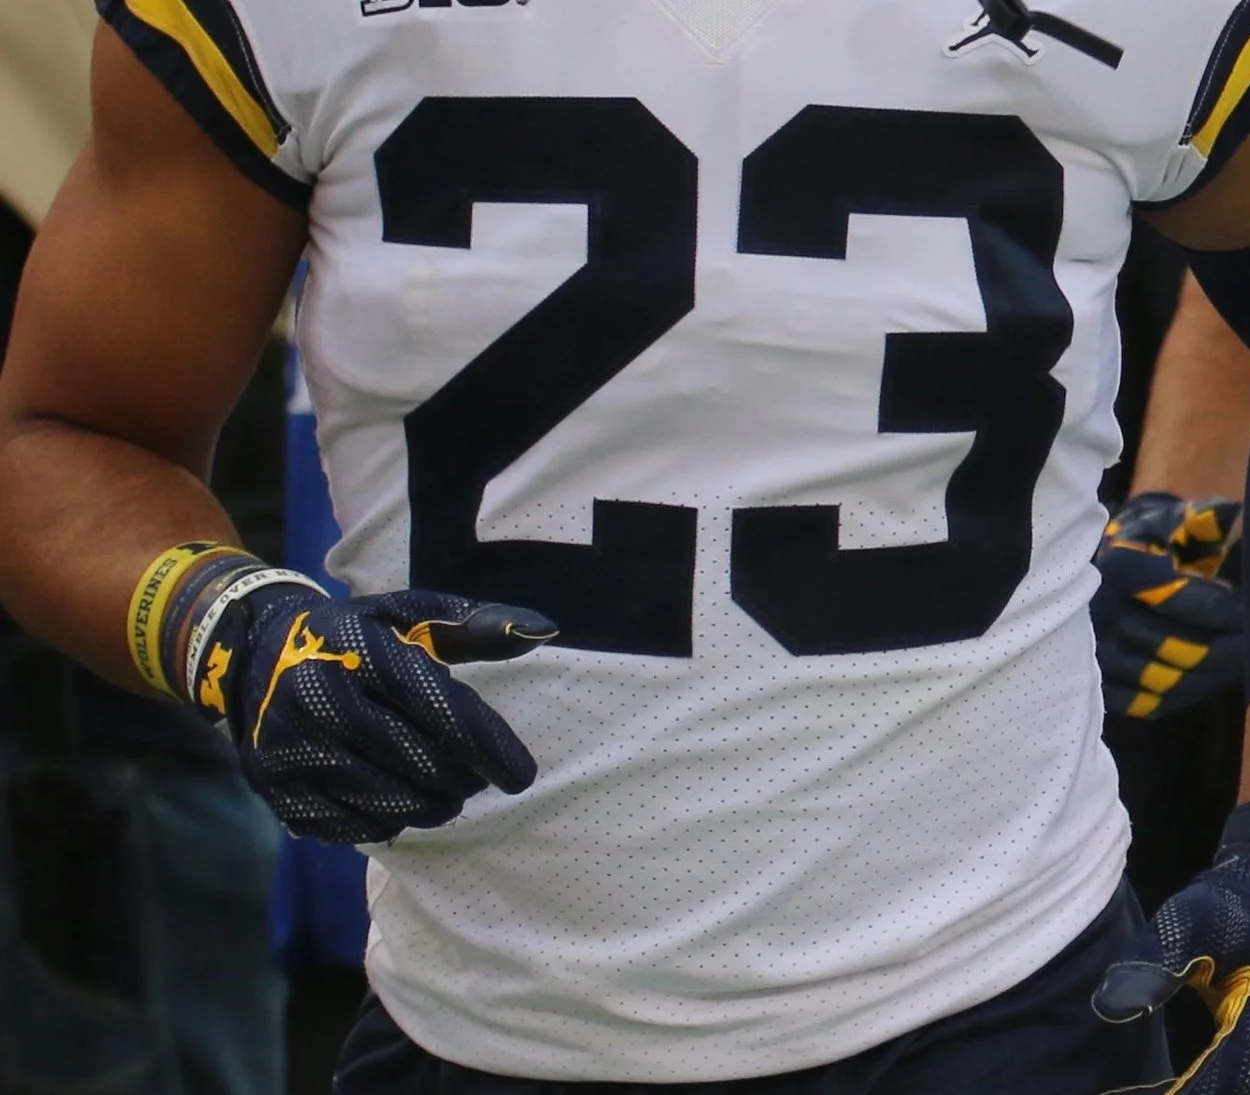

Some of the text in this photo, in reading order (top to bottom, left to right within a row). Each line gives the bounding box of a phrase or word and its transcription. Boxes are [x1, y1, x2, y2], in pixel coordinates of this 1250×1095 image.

[373, 96, 1074, 658] 23
[134, 557, 178, 679] WOLVERINES
[219, 573, 268, 605] OVER
